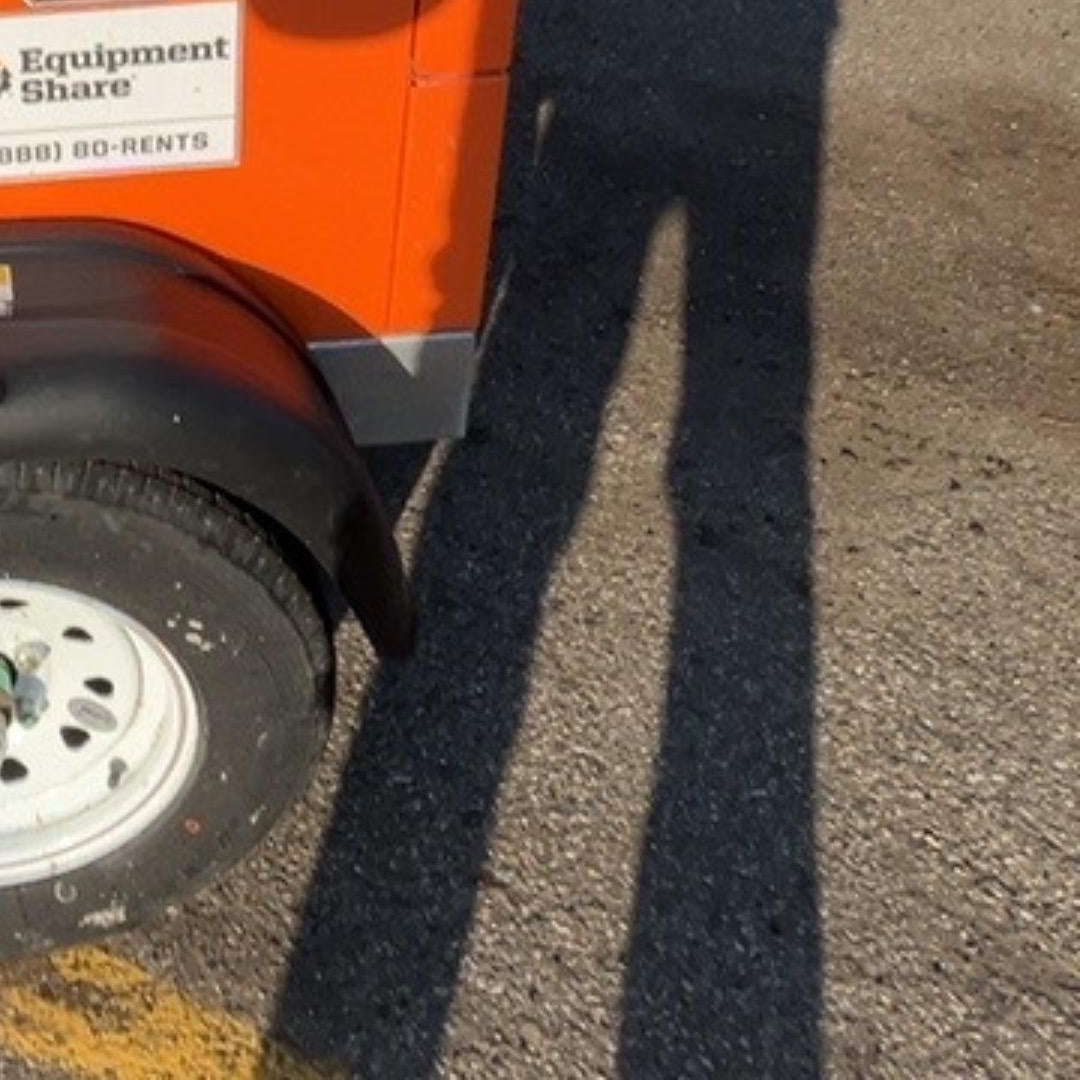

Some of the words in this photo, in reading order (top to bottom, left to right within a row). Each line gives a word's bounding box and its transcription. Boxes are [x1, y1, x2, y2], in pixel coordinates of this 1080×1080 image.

[19, 36, 230, 77] Equipment
[21, 78, 133, 105] Share
[72, 132, 209, 160] 80-RENTS
